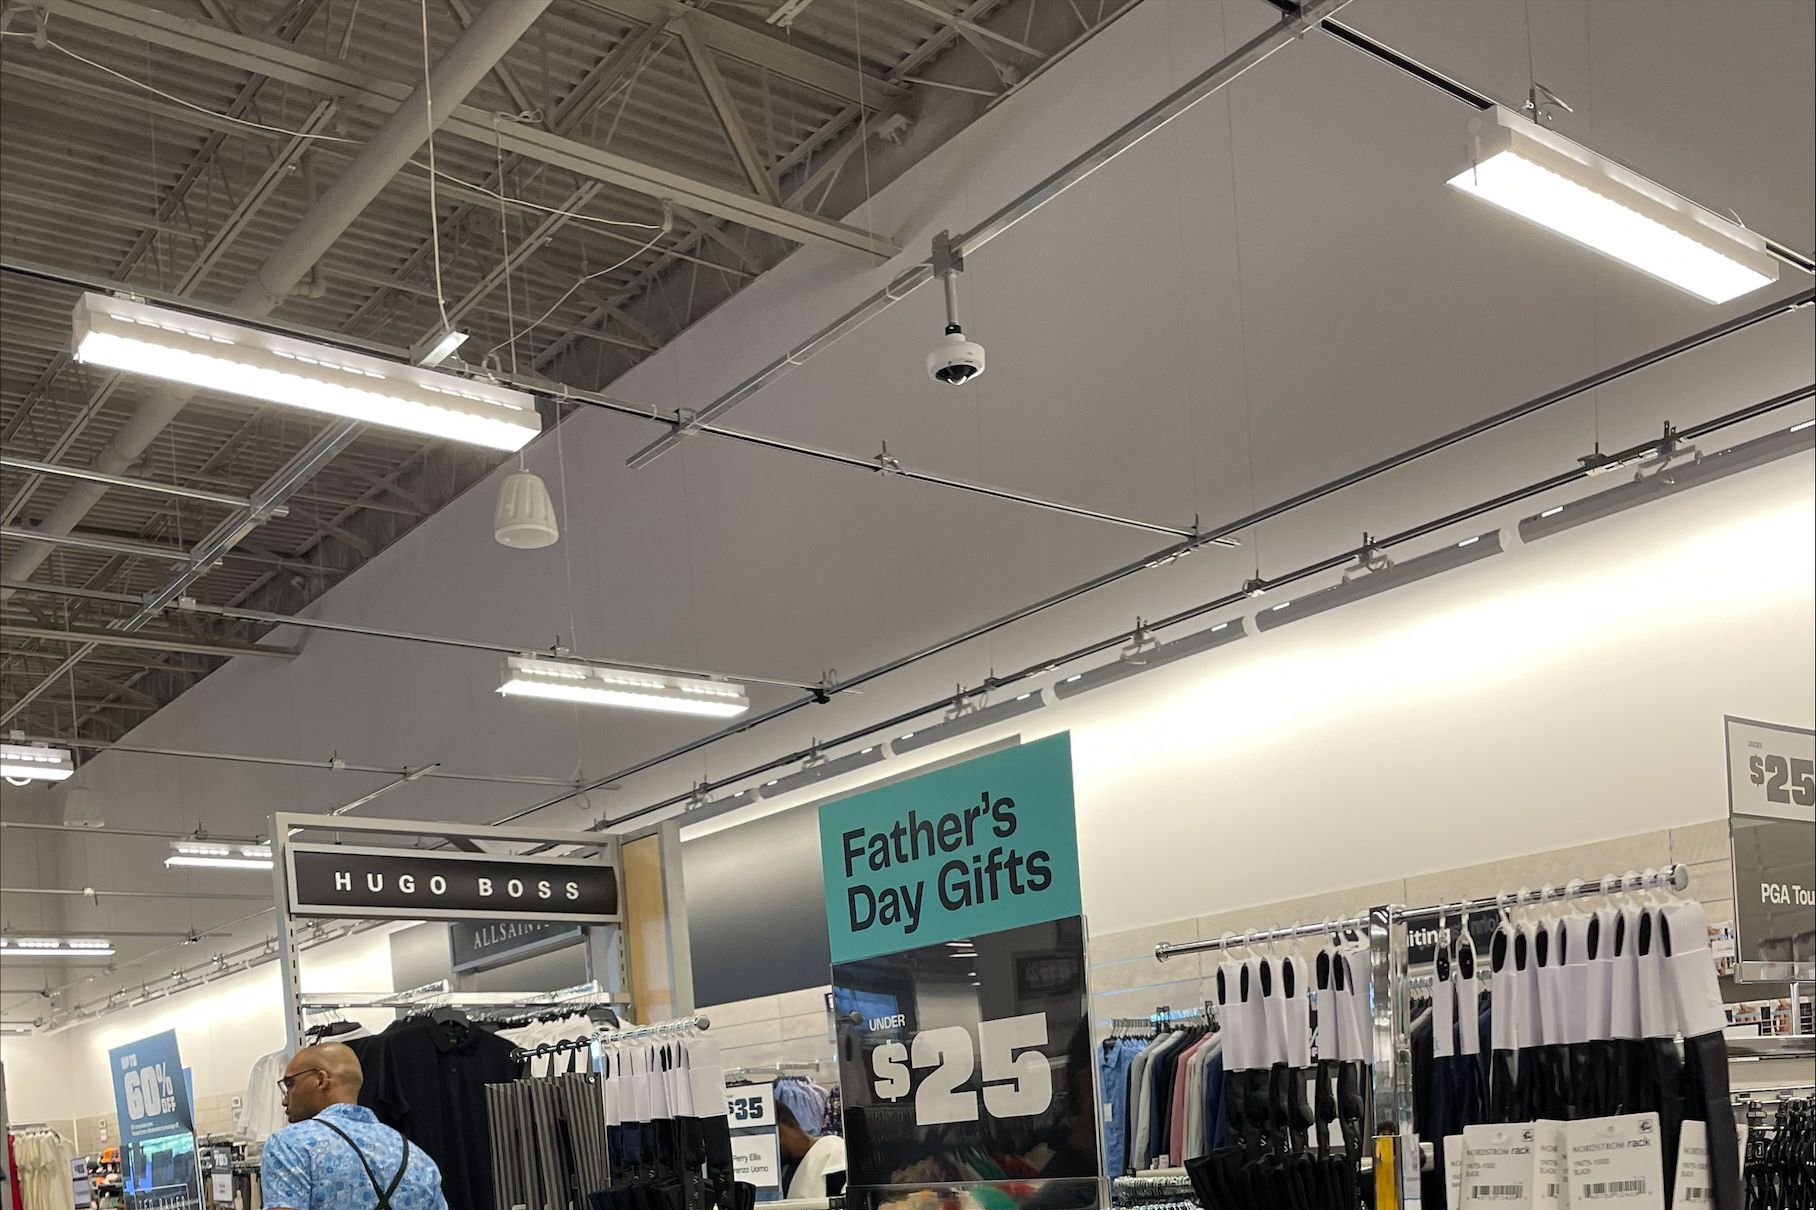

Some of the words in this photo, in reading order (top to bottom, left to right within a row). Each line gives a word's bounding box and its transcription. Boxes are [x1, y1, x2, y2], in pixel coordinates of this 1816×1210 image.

[1750, 753, 1815, 807] $25
[843, 791, 1017, 878] Father's
[334, 872, 447, 895] HUGO
[478, 877, 580, 900] BOSS
[847, 881, 925, 935] Day
[938, 846, 1053, 911] Gifts
[1761, 883, 1791, 905] PGA
[474, 922, 550, 950] ALLSAIN
[869, 1014, 906, 1032] UNDER
[872, 1012, 1053, 1126] $25
[124, 1062, 174, 1121] 60%
[161, 1096, 177, 1114] OFF
[728, 1096, 764, 1120] $35
[1511, 1146, 1531, 1155] rack
[1626, 1137, 1652, 1149] rack
[749, 1153, 762, 1161] Ellis
